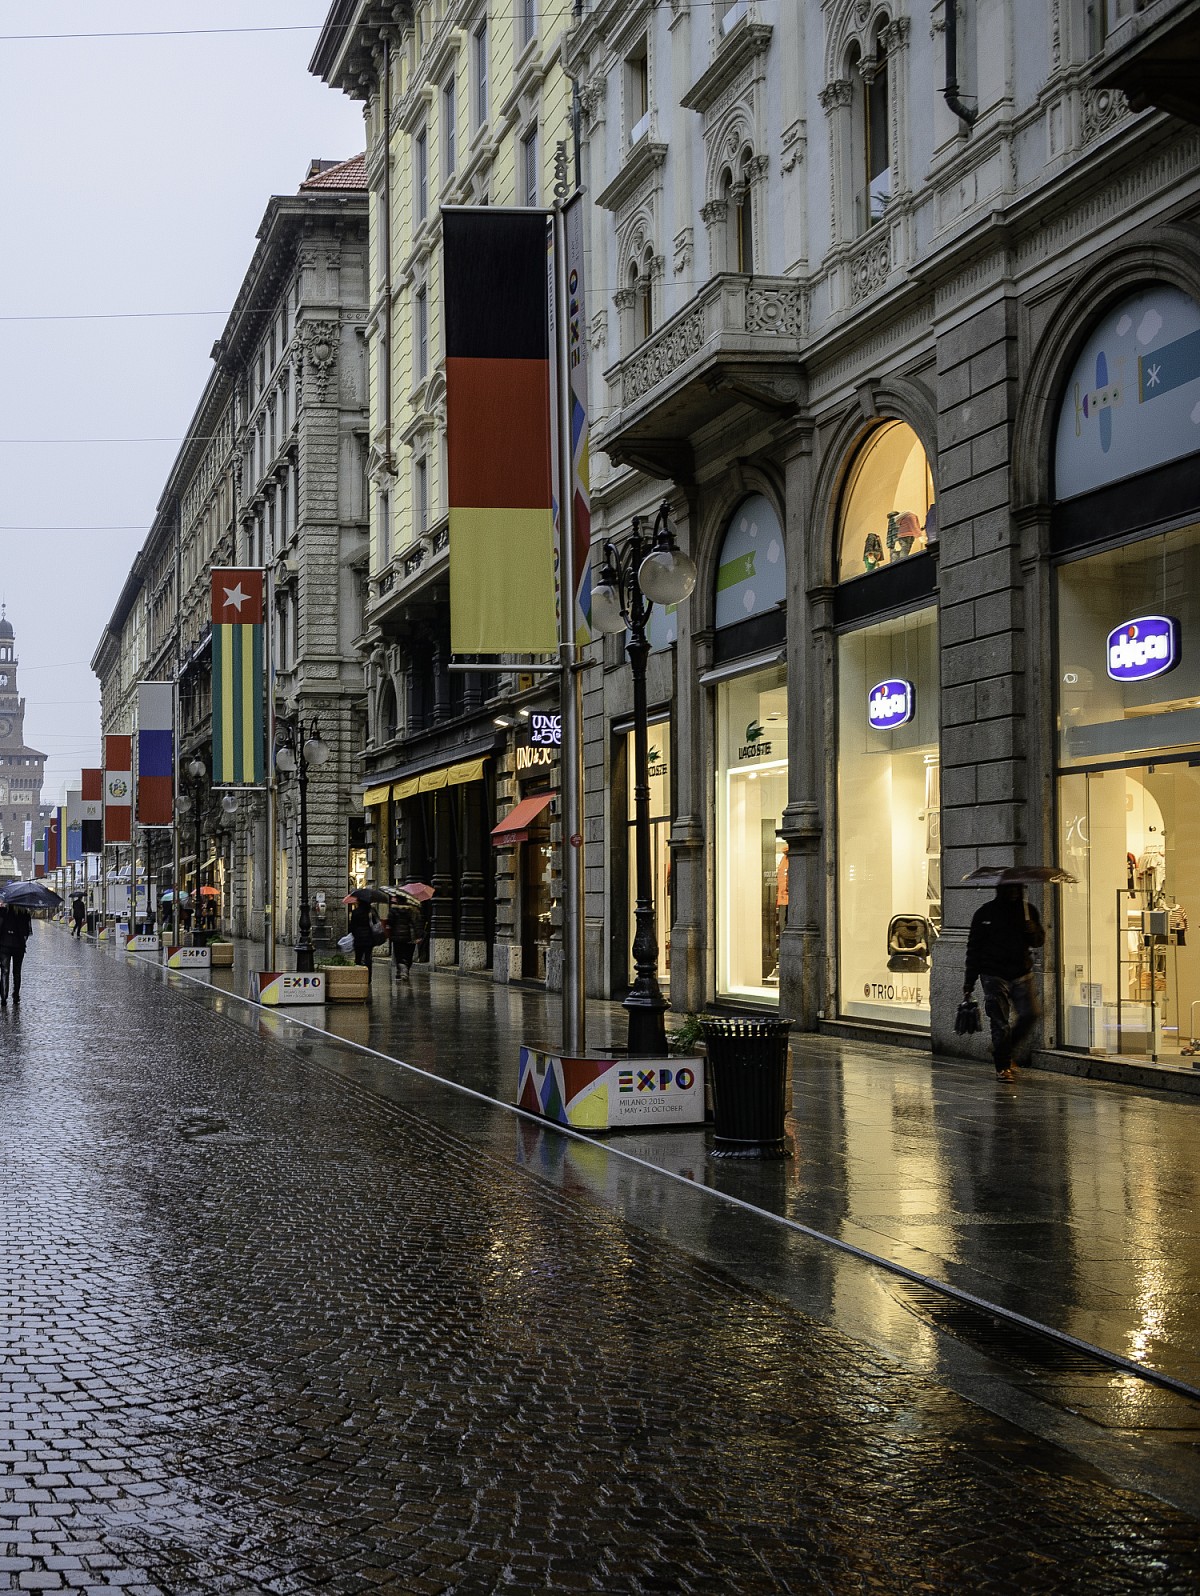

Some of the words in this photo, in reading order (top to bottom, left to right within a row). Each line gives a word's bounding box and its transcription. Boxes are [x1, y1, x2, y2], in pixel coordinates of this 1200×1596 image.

[569, 268, 580, 370] EXPO
[739, 741, 772, 760] LACOSTE
[182, 949, 208, 957] EXPO
[283, 977, 321, 988] EXPO
[618, 1068, 695, 1093] EXPO
[620, 1098, 647, 1106] MILANO
